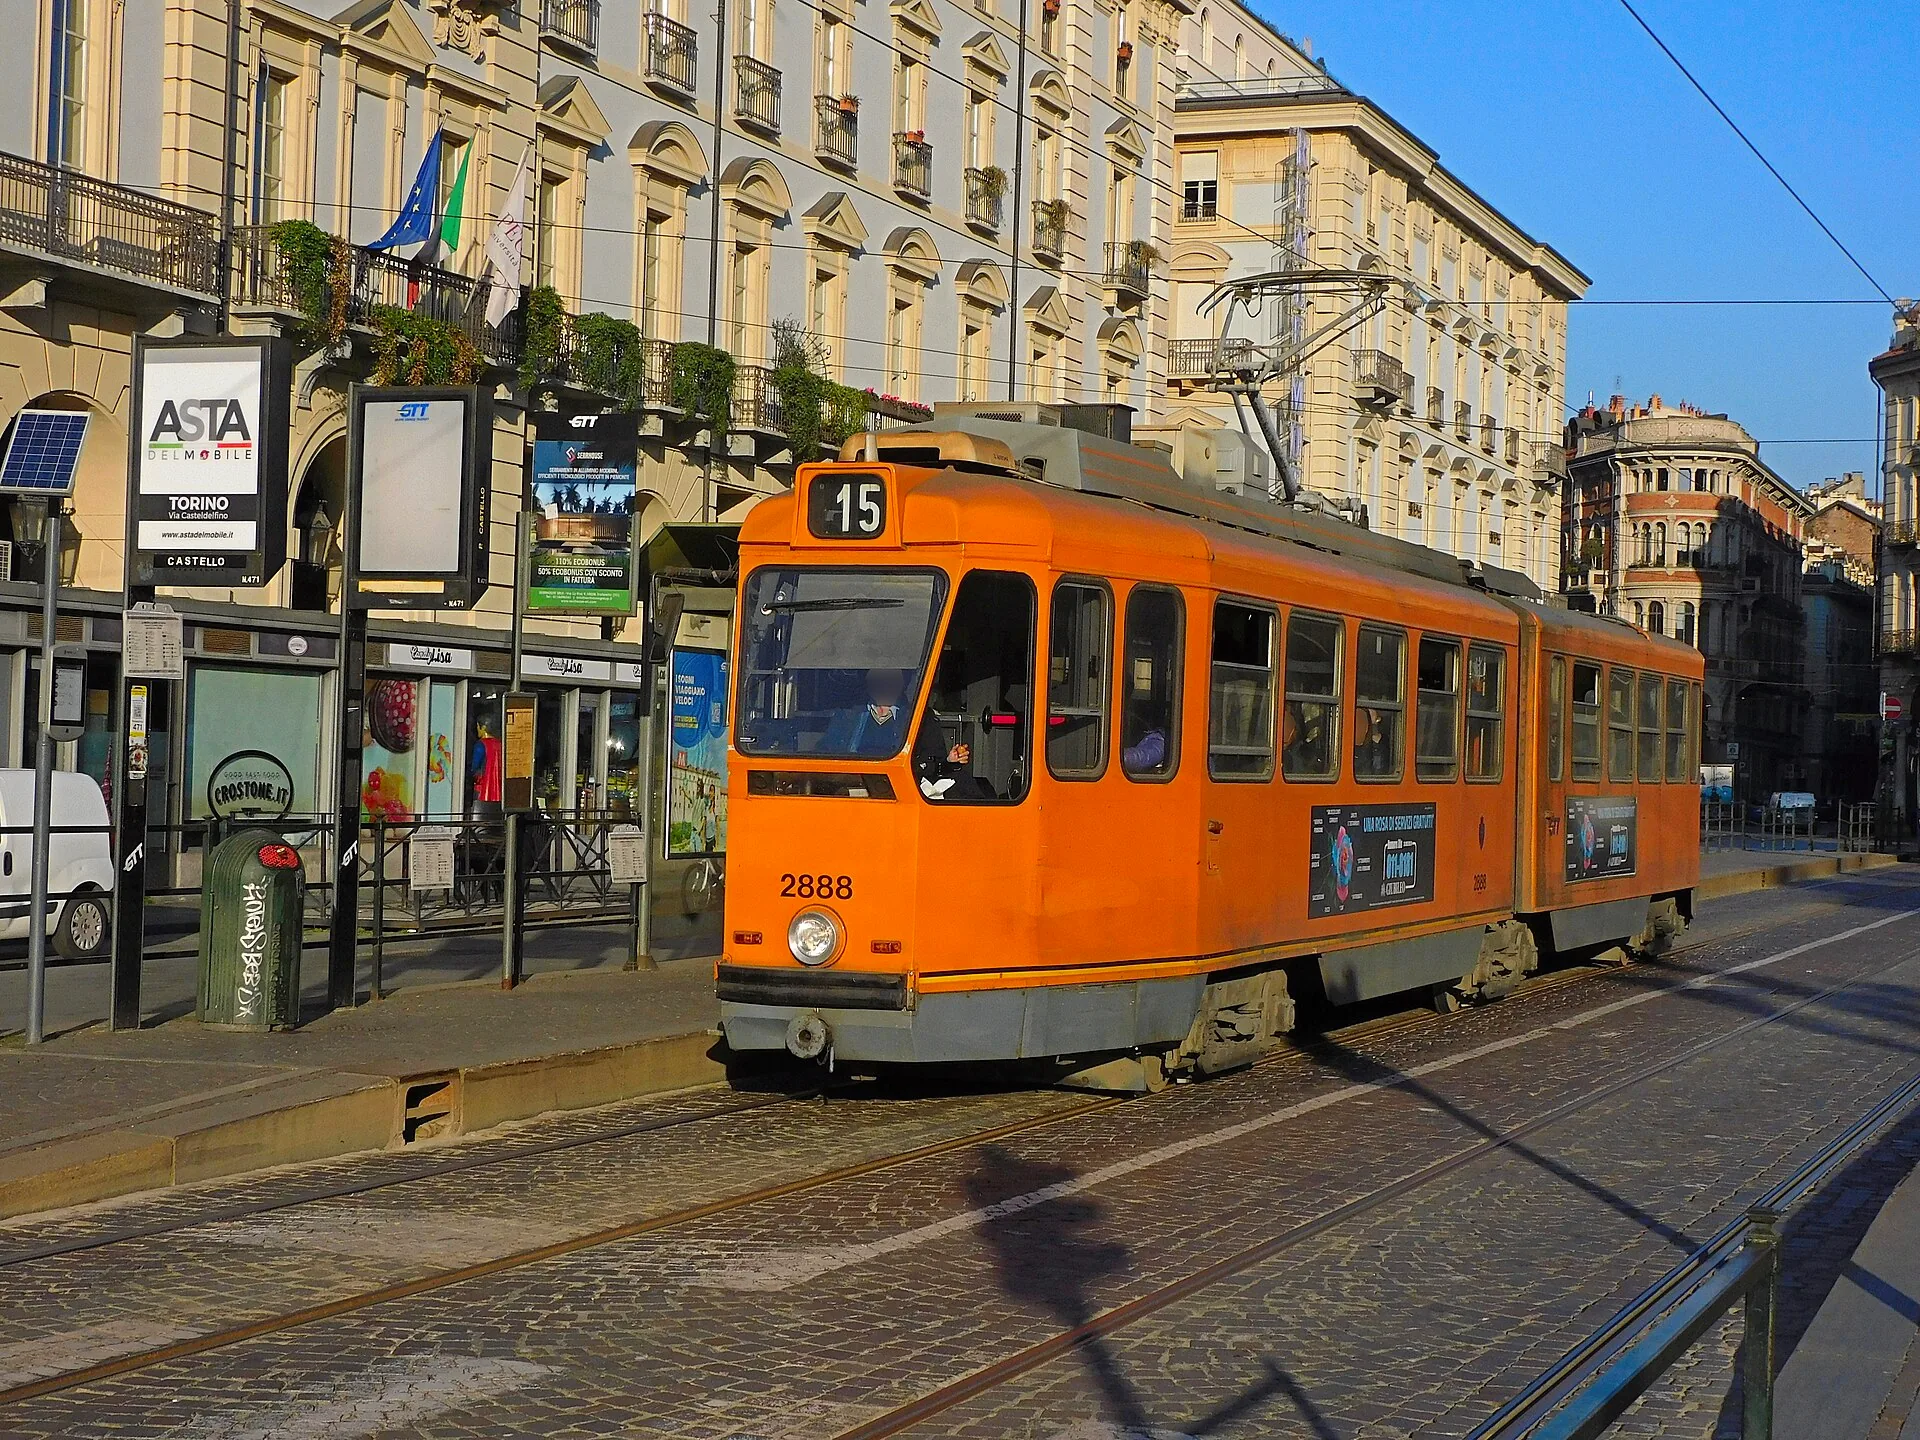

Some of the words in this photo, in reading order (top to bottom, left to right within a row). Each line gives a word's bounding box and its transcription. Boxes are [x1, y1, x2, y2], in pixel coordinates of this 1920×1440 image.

[396, 403, 430, 418] GTT
[149, 398, 251, 441] ASTA
[568, 415, 599, 428] GTT
[168, 496, 229, 511] TORINO
[478, 486, 486, 535] CASTELLO
[836, 483, 881, 532] 15
[168, 511, 180, 519] Via
[181, 511, 229, 519] Casteldelfino
[161, 531, 234, 539] www.astadelmobile.it
[167, 556, 225, 567] CASTELLO
[555, 557, 573, 566] 110%
[573, 558, 606, 567] ECOBONUS
[537, 567, 552, 576] 50%
[552, 568, 584, 577] ECOBONUS
[584, 569, 598, 577] CON
[598, 569, 623, 577] SCONTO
[132, 723, 143, 731] 471
[214, 780, 289, 806] CROSTONE.IT
[1363, 816, 1375, 833] UNA
[1375, 816, 1389, 832] ROSA
[1389, 815, 1395, 831] DI
[1395, 815, 1413, 831] SERVIZI
[122, 842, 143, 872] GTT
[341, 839, 358, 867] GTT
[780, 873, 853, 900] 2888
